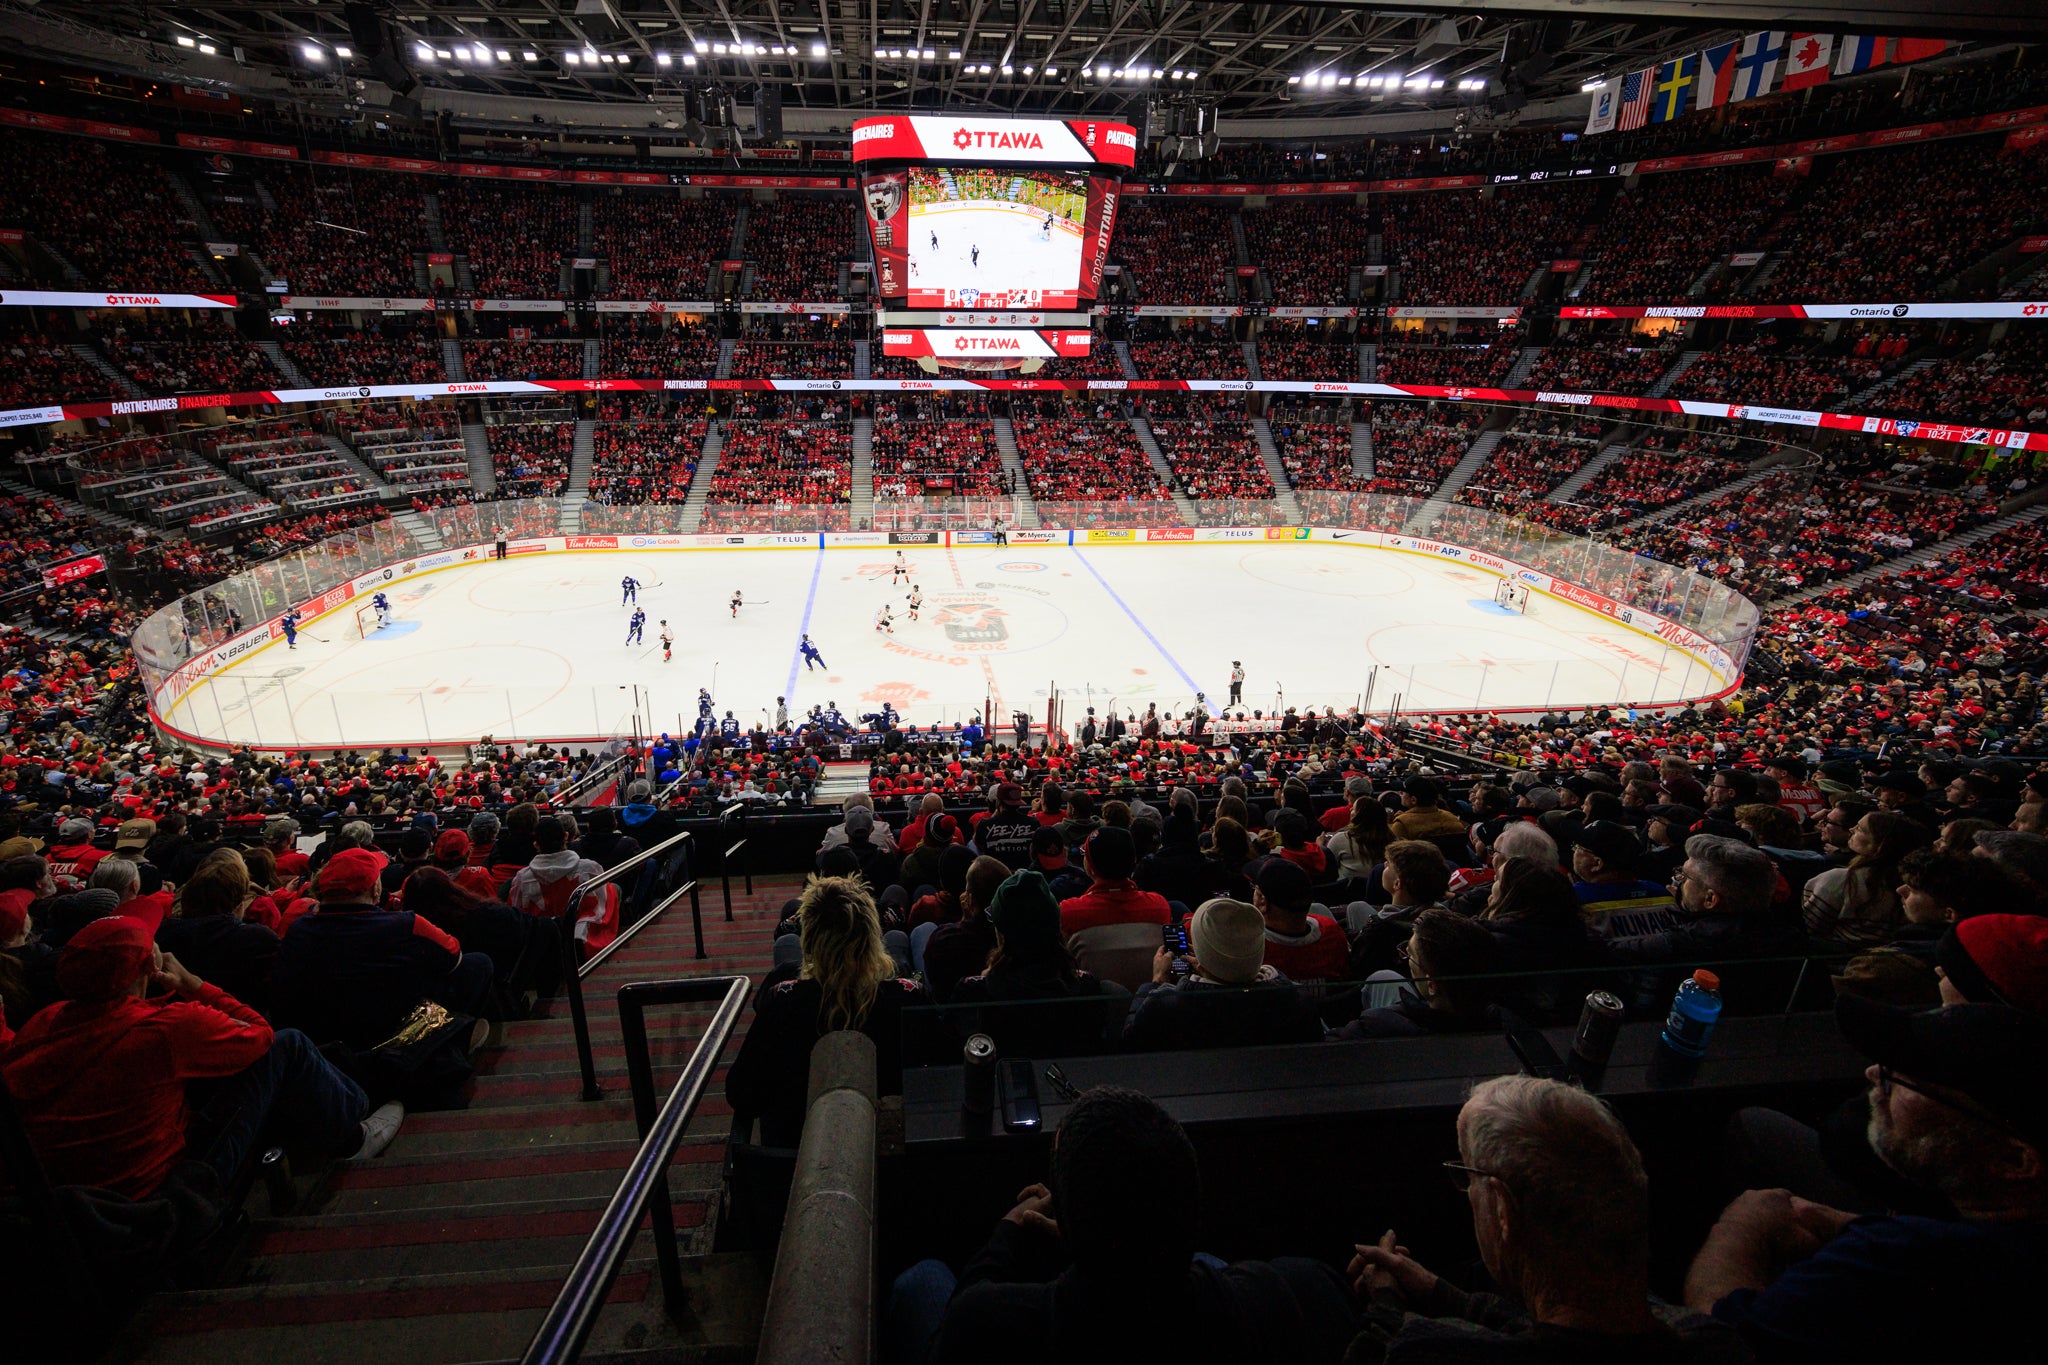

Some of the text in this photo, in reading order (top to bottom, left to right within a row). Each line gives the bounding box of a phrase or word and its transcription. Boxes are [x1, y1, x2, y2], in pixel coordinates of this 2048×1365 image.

[953, 128, 1043, 150] OTTAWA
[1494, 175, 1501, 183] 0
[1609, 165, 1617, 174] 0
[1091, 192, 1117, 286] 2025 OTTAWA
[107, 293, 161, 304] OTTAWA
[949, 289, 956, 300] 0
[1031, 290, 1038, 301] 0
[1645, 306, 1755, 318] PARTNENAIRES FINANCIERS
[1850, 307, 1890, 317] Ontario
[955, 336, 1020, 352] OTTAWA
[448, 384, 488, 393] OTTAWA
[663, 380, 707, 389] PARTNENAIRES
[901, 381, 933, 389] OTTAWA
[1314, 383, 1348, 391] OTTAWA
[325, 390, 358, 398] Ontario
[1535, 392, 1593, 405] PARTNENAIRES
[112, 394, 231, 415] PARTNENAIRES FINANCIERS
[1881, 420, 1891, 433] 0
[1927, 429, 1952, 441] 10:21
[1995, 430, 2006, 445] 0
[1225, 530, 1254, 538] TELUS
[568, 537, 618, 549] Tim Hortons
[776, 537, 808, 545] TELUS
[1417, 541, 1462, 557] IIHF APP
[1469, 553, 1505, 570] OTTAWA
[359, 576, 383, 589] Ontario
[323, 587, 345, 603] ACCESS
[1567, 584, 1600, 609] Hortons
[1620, 609, 1633, 624] 50
[1657, 620, 1710, 655] Molson
[882, 641, 970, 667] OTTAWA
[170, 653, 216, 699] Molson
[724, 722, 736, 732] 35
